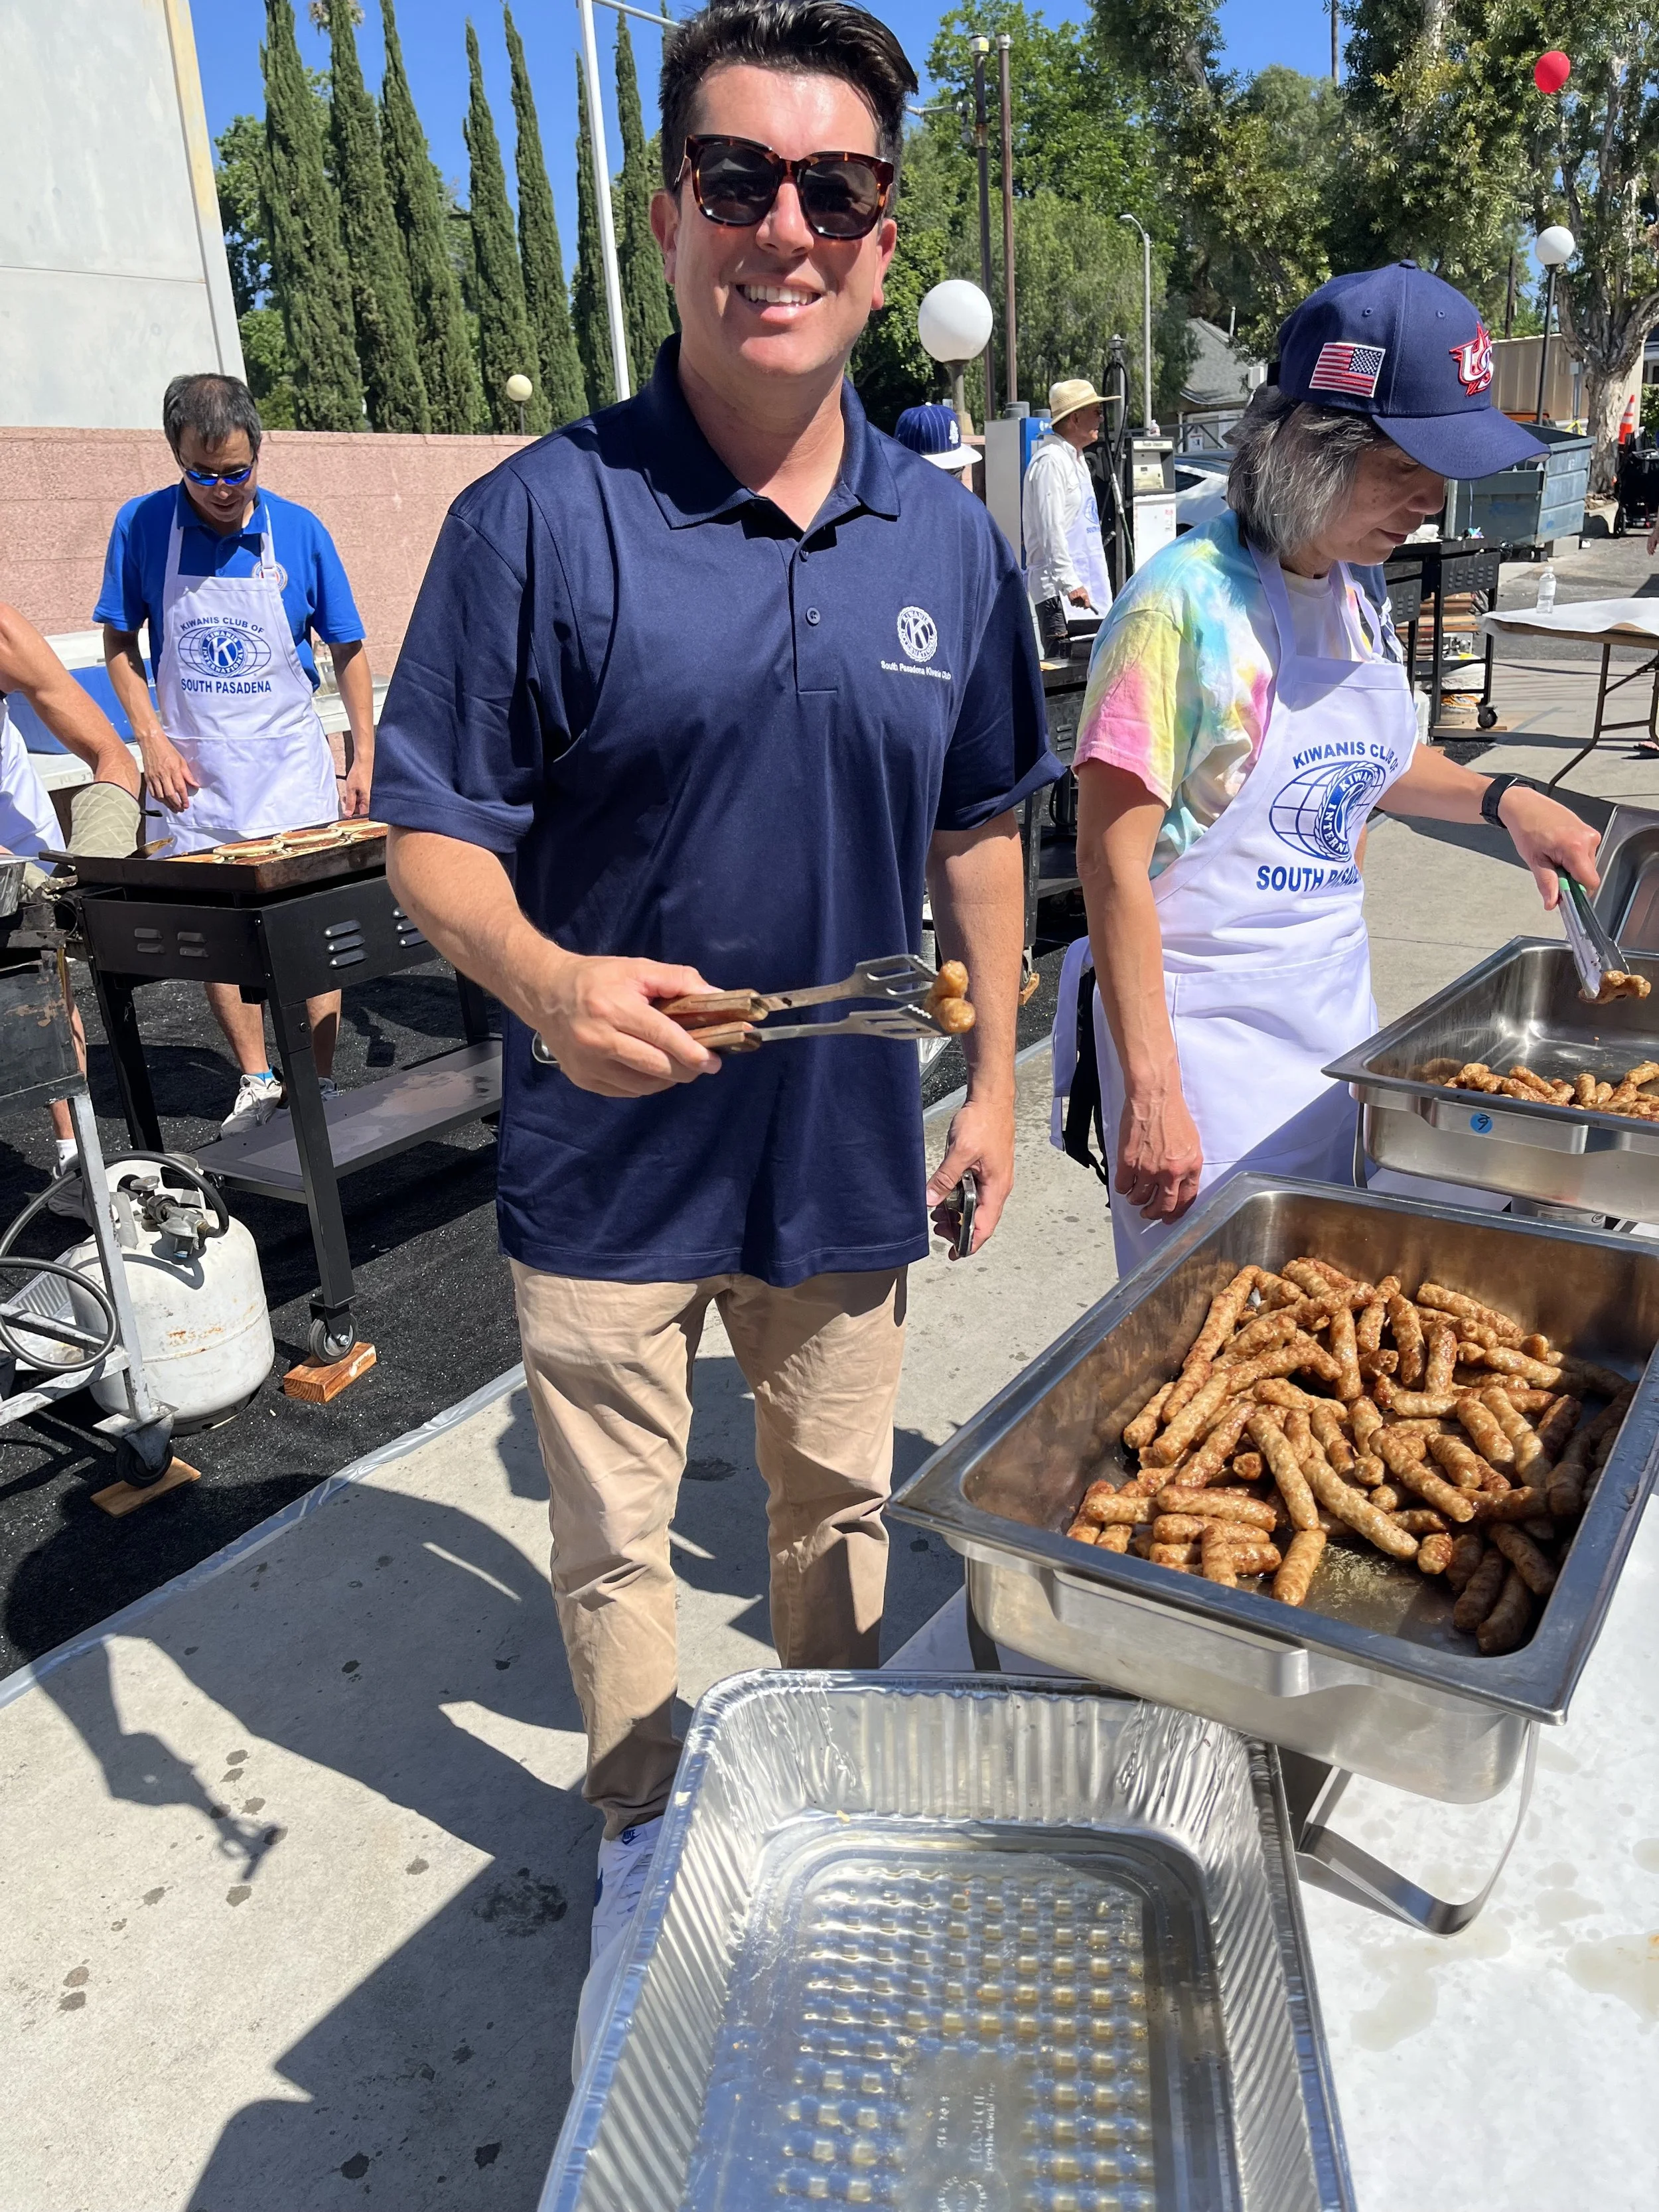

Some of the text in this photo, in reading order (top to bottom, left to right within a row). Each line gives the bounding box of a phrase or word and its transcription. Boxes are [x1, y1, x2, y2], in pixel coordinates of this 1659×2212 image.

[180, 617, 264, 634] KIWANIS CLUB OF
[206, 630, 238, 642] KIWANIS
[202, 646, 244, 674] INTERNATIONAL
[211, 636, 234, 667] K
[180, 678, 271, 694] SOUTH PASADENA
[1292, 741, 1366, 769] KIWANIS
[1370, 743, 1395, 765] CLUB
[1256, 865, 1325, 892] SOUTH
